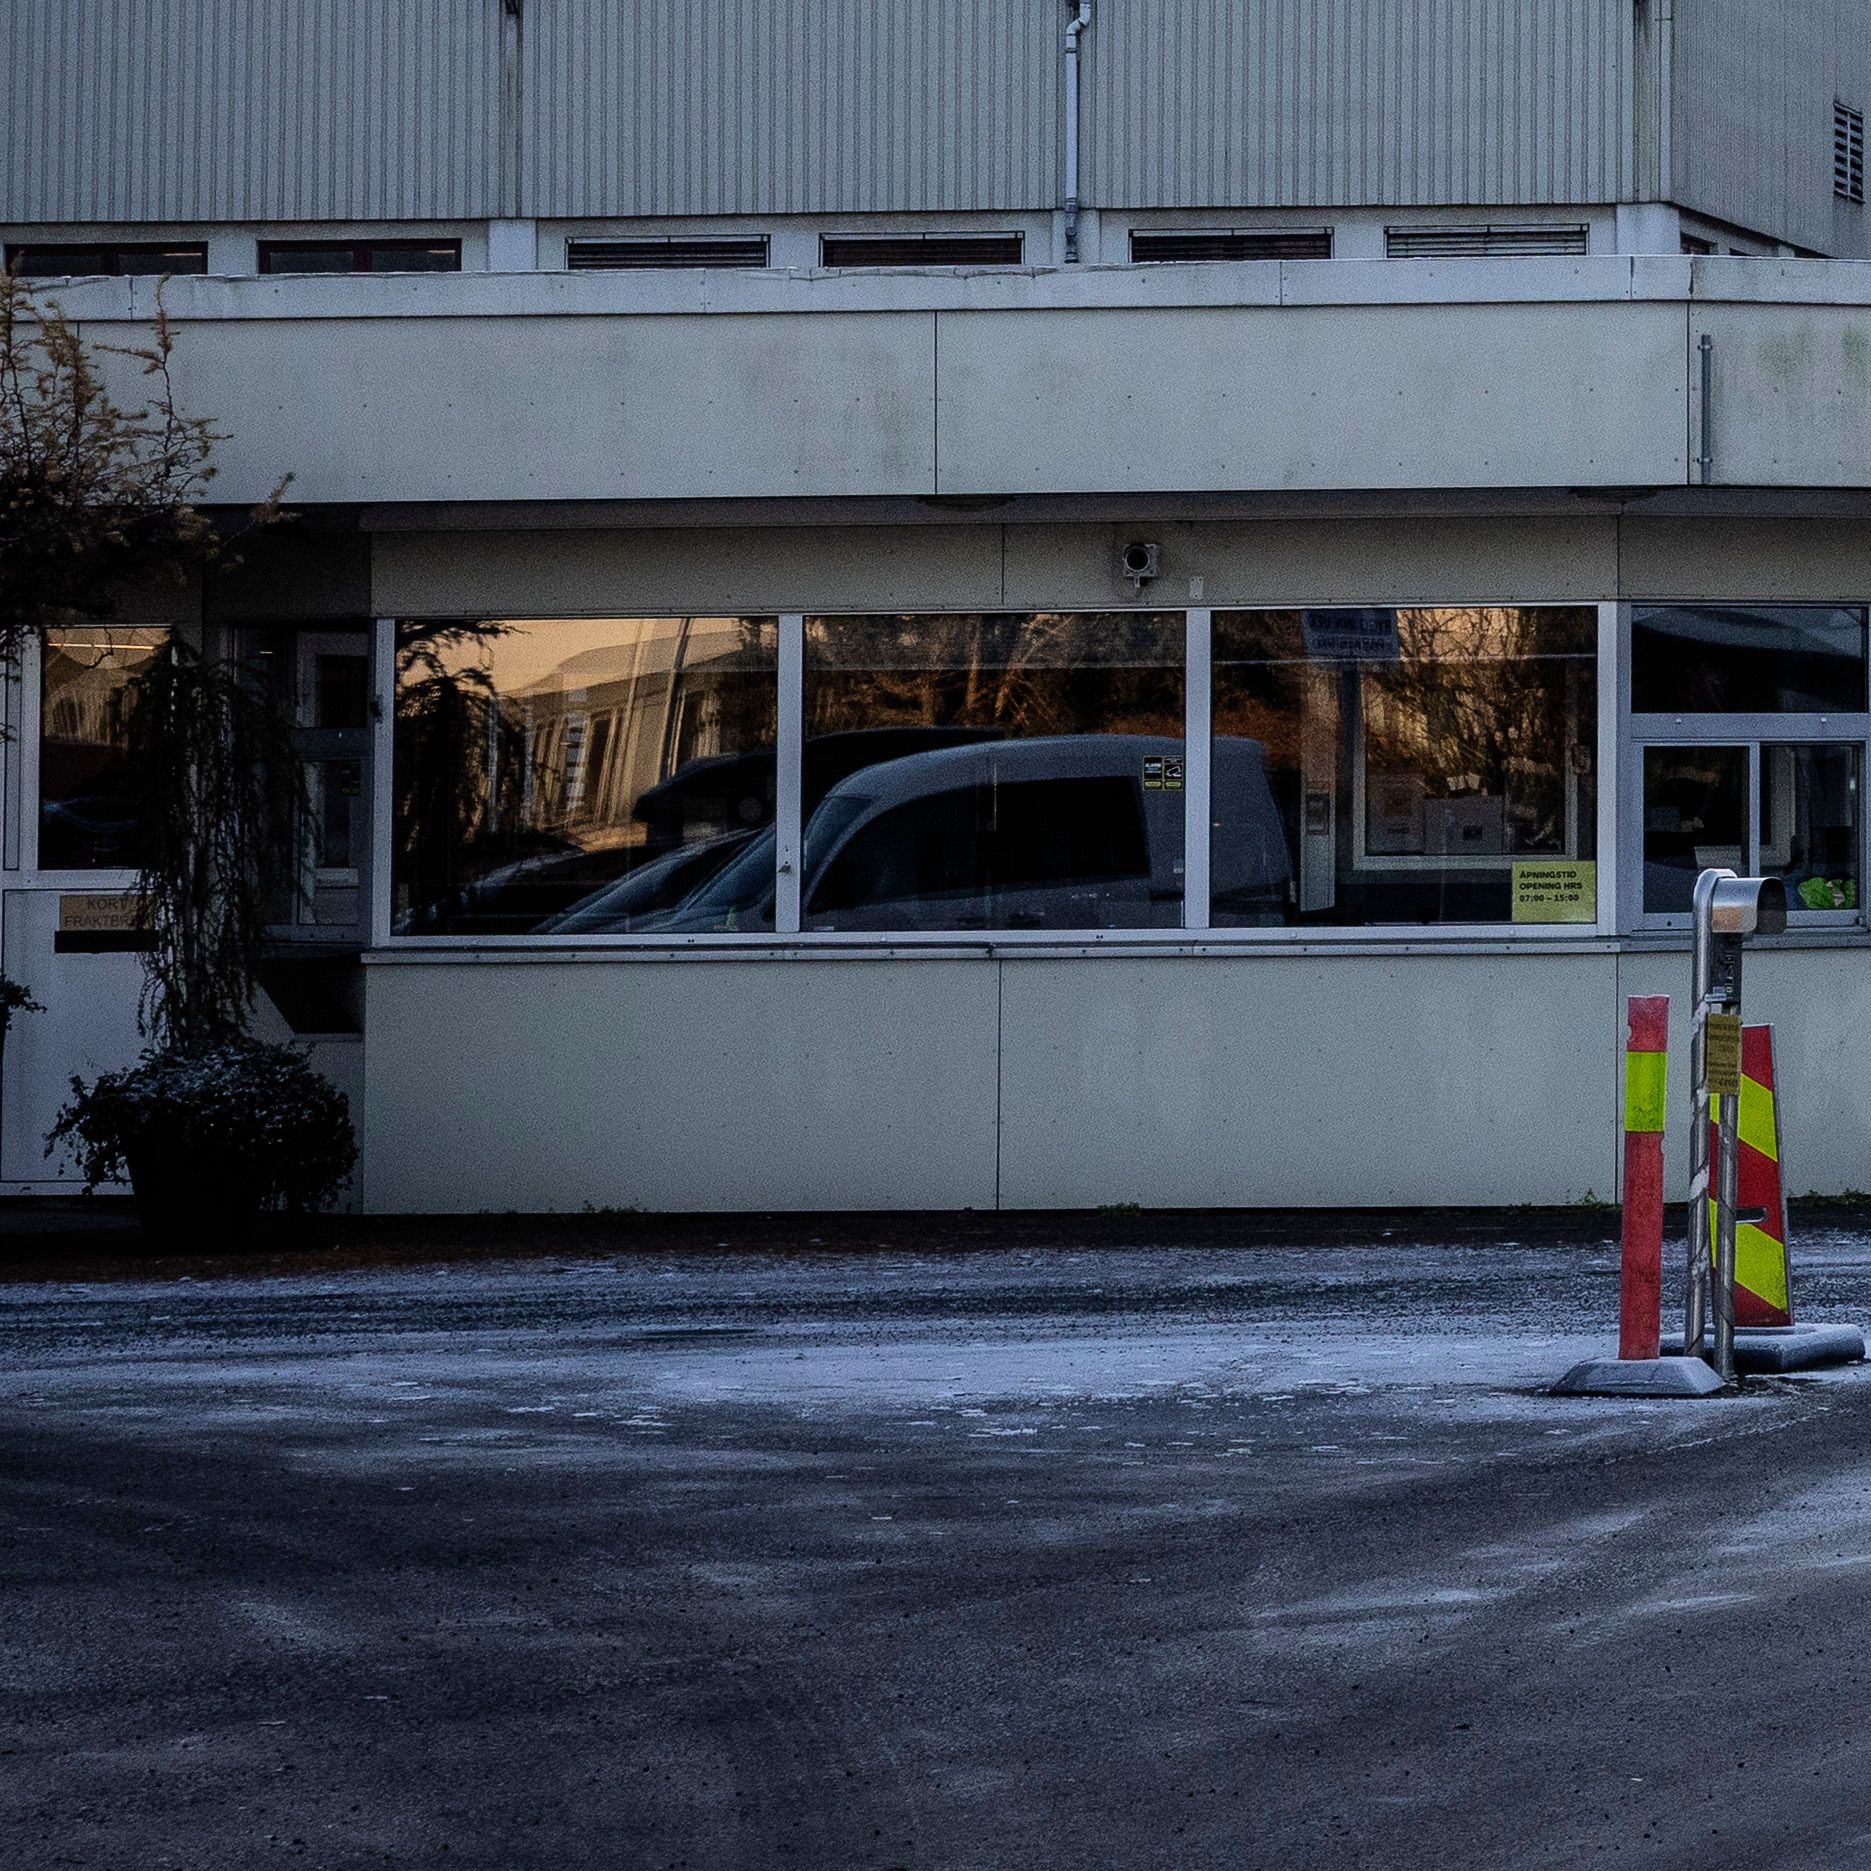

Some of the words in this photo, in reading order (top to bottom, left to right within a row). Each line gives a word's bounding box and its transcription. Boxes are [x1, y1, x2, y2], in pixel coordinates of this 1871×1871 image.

[1519, 882, 1561, 890] OPENING
[1519, 894, 1545, 902] 07:00
[1554, 894, 1579, 902] 15:00
[87, 897, 128, 911] KORT
[64, 914, 151, 928] FRAKTBR
